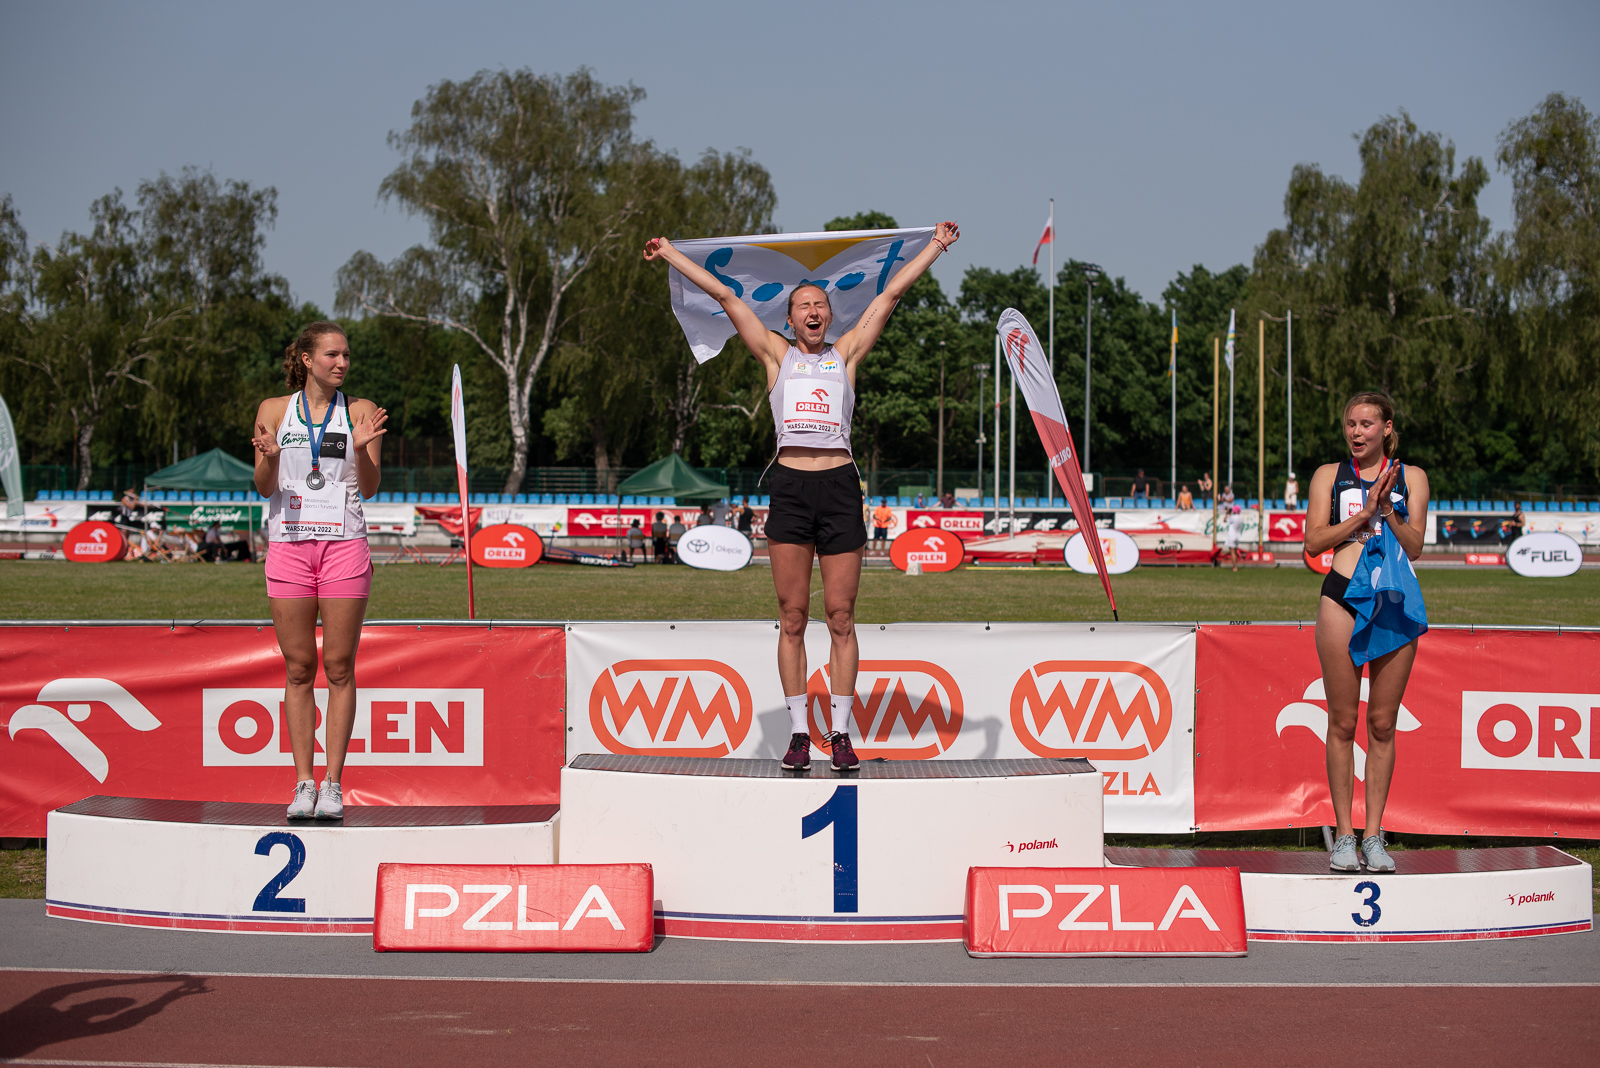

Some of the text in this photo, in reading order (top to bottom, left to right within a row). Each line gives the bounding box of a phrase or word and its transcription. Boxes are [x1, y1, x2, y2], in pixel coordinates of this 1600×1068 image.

[797, 403, 828, 412] ORLEN
[281, 432, 310, 446] Europo
[285, 525, 316, 533] WARSZAWA
[943, 520, 981, 529] ORLEN
[1034, 518, 1058, 531] 4F
[77, 544, 104, 552] ORLEN
[487, 549, 523, 558] ORLEN
[715, 545, 743, 555] Okęcie
[910, 554, 944, 562] ORLEN
[1531, 550, 1575, 562] FUEL
[600, 668, 742, 751] WM
[1021, 669, 1164, 751] WM
[1476, 703, 1600, 760] OR
[1101, 771, 1162, 796] ZLA
[802, 785, 858, 913] 1
[1018, 838, 1058, 853] polanik
[252, 831, 306, 913] 2
[1351, 881, 1381, 927] 3
[1517, 891, 1556, 906] polanik
[404, 884, 625, 931] PZLA
[998, 884, 1221, 931] PZLA
